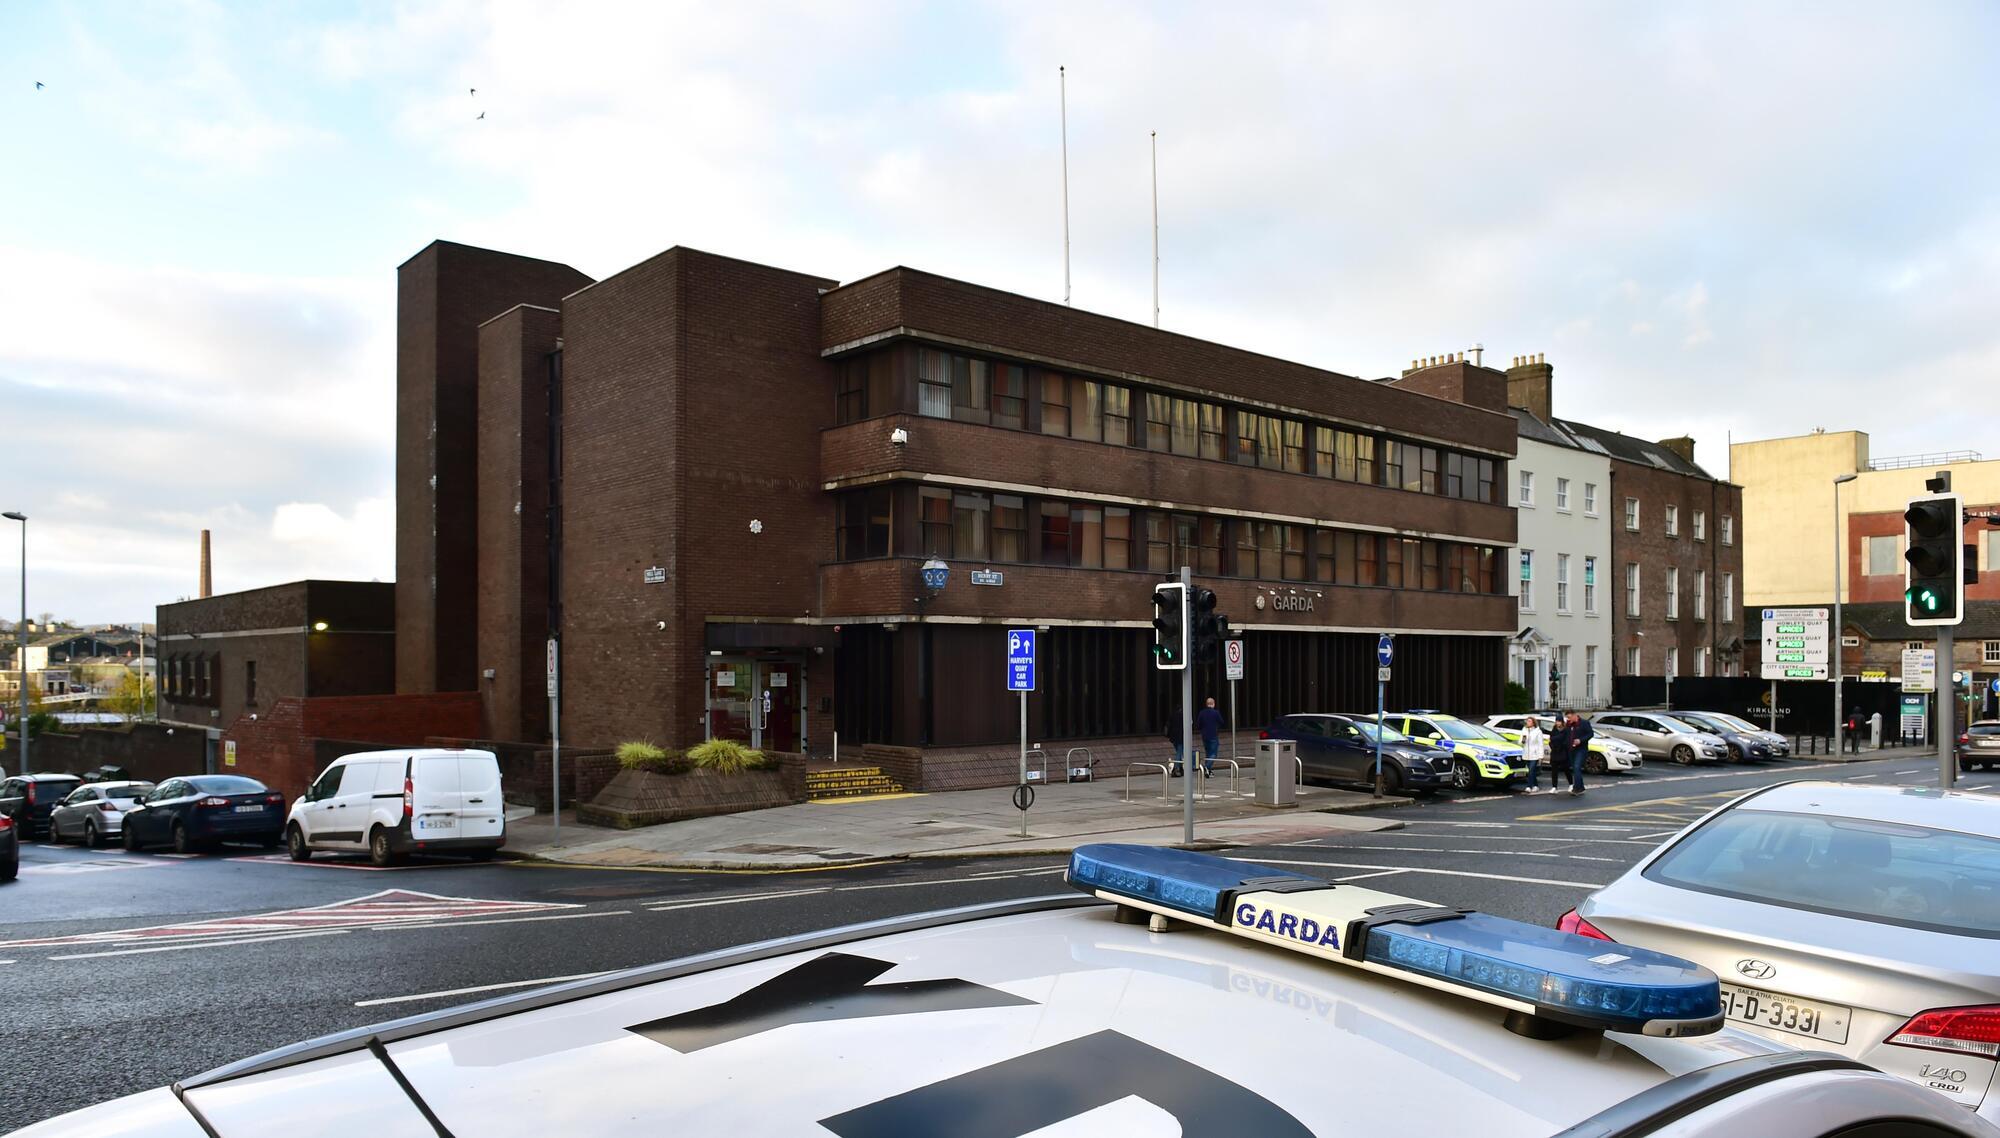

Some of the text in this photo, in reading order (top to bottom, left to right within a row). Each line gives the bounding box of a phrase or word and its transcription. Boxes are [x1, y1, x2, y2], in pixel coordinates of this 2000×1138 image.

[1273, 595, 1314, 612] GARDA
[1010, 639, 1021, 655] P
[1014, 680, 1028, 688] PARK
[1236, 903, 1341, 951] GARDA
[1737, 987, 1755, 998] BAILE
[1773, 995, 1796, 1005] CLIATH
[1919, 1063, 1967, 1083] i40
